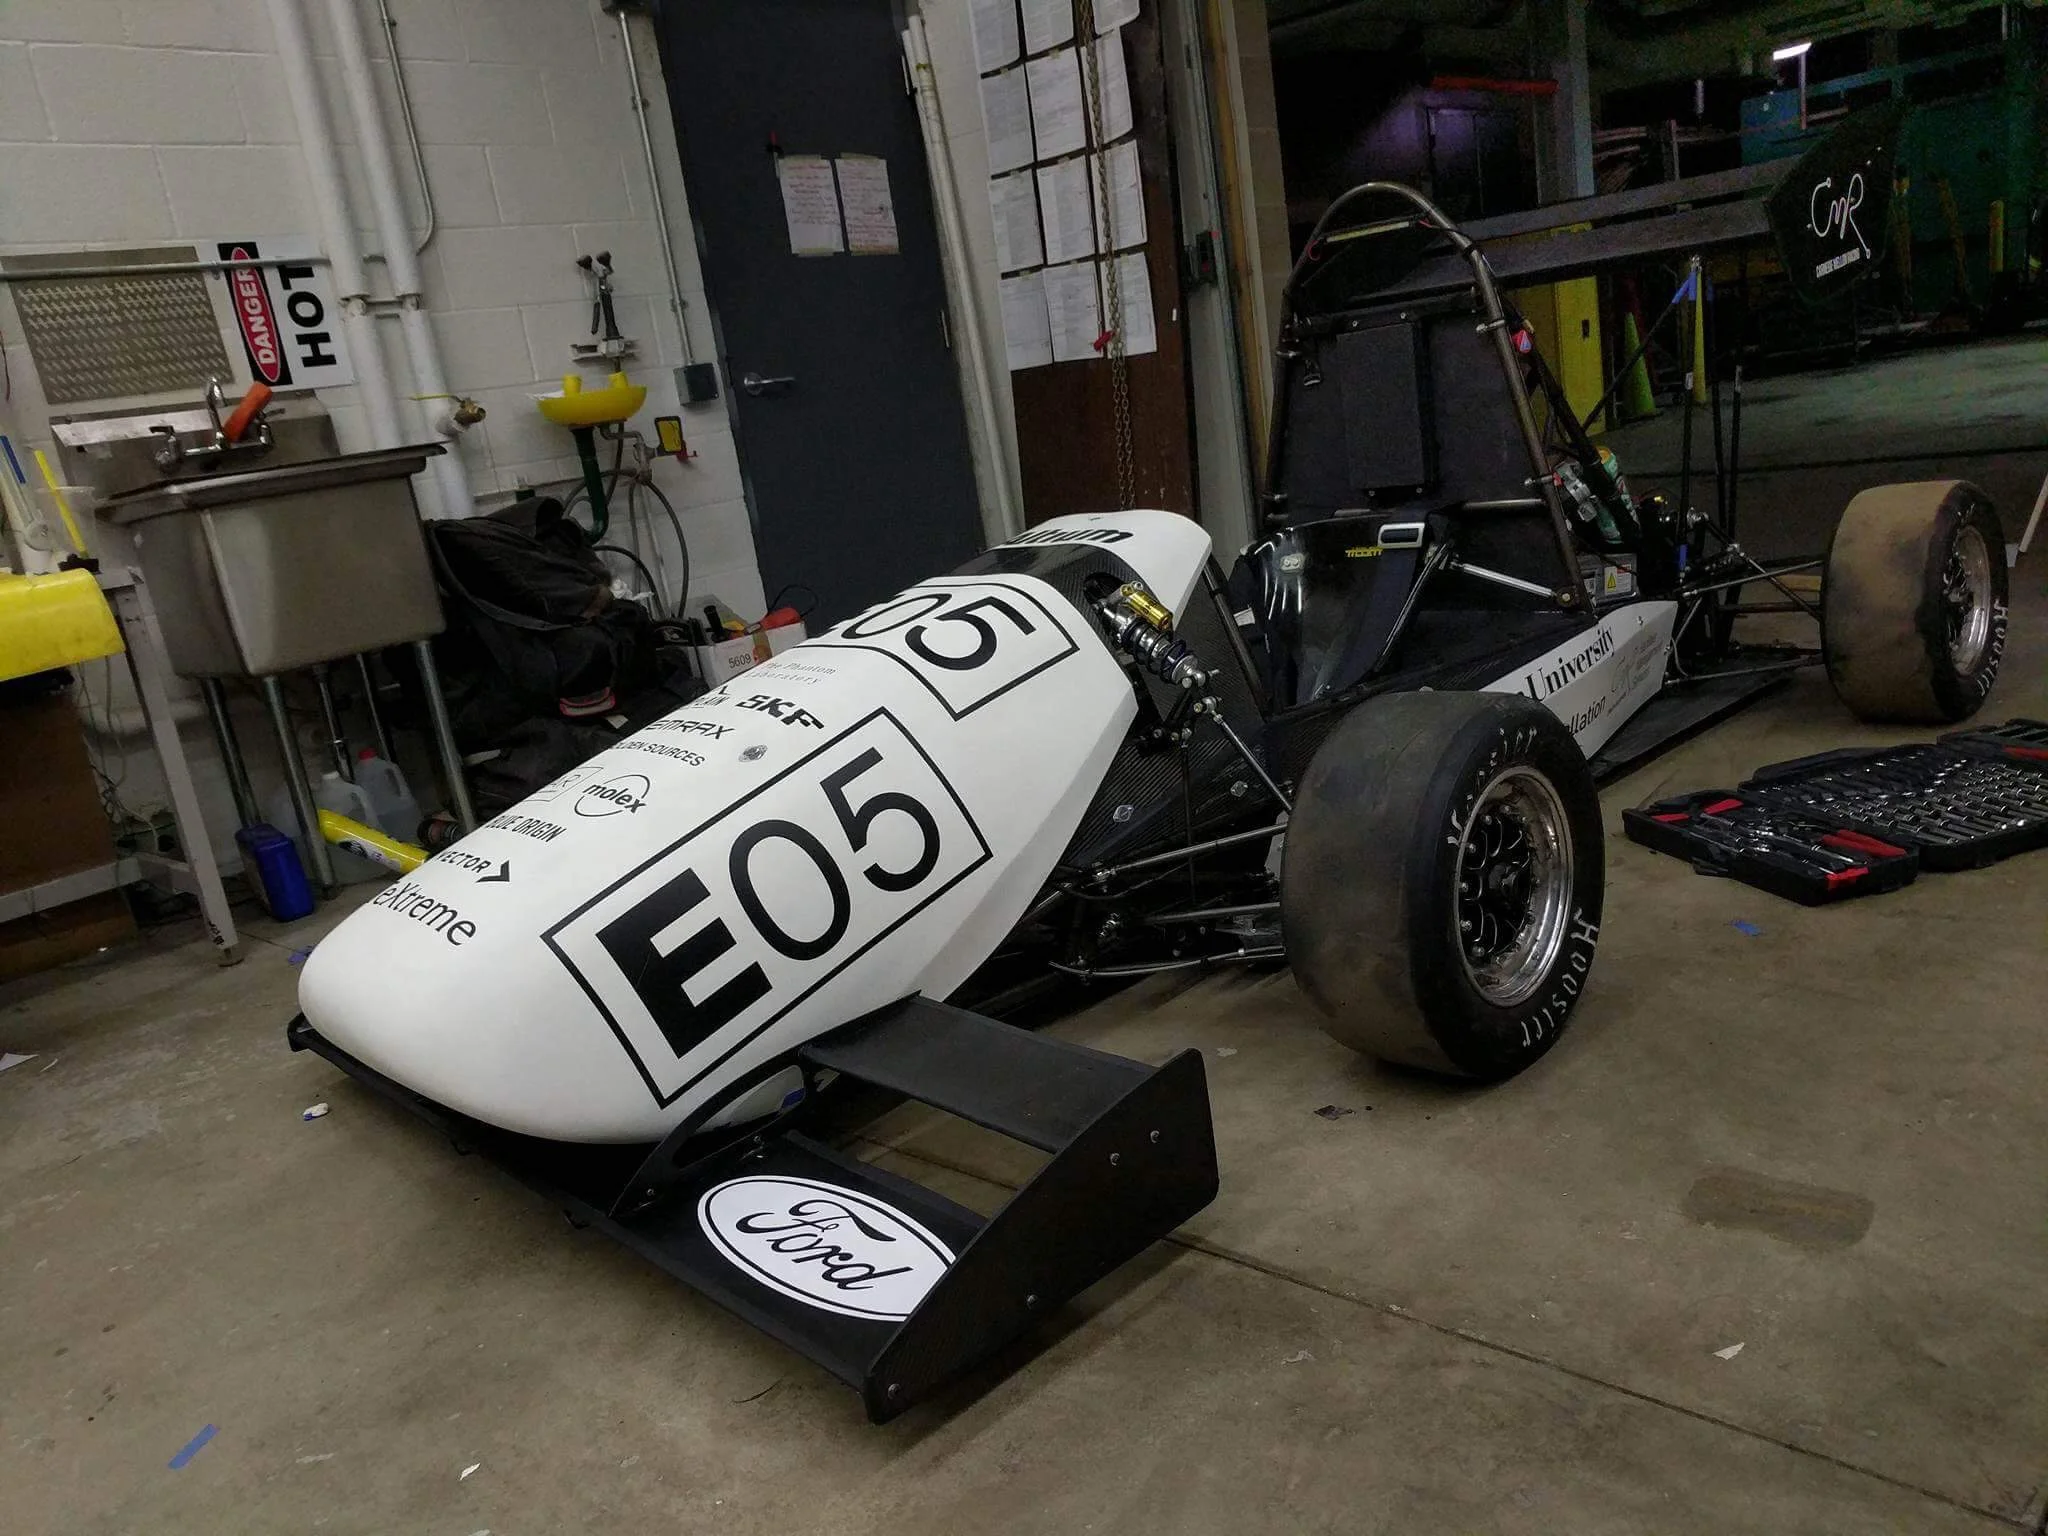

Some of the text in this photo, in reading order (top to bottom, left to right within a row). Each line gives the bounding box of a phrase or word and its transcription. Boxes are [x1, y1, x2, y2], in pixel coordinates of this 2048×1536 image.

[235, 266, 276, 365] DANGER
[277, 264, 337, 368] HOT
[728, 653, 752, 669] 5609
[828, 592, 1037, 671] 05
[1523, 624, 1616, 702] University
[736, 694, 825, 729] SKF
[643, 743, 706, 767] SOURCES
[511, 818, 567, 843] ORIGIN
[581, 784, 647, 813] molex
[595, 746, 941, 1060] E05
[1521, 908, 1600, 1047] Hoosier
[735, 1199, 914, 1290] Ford
